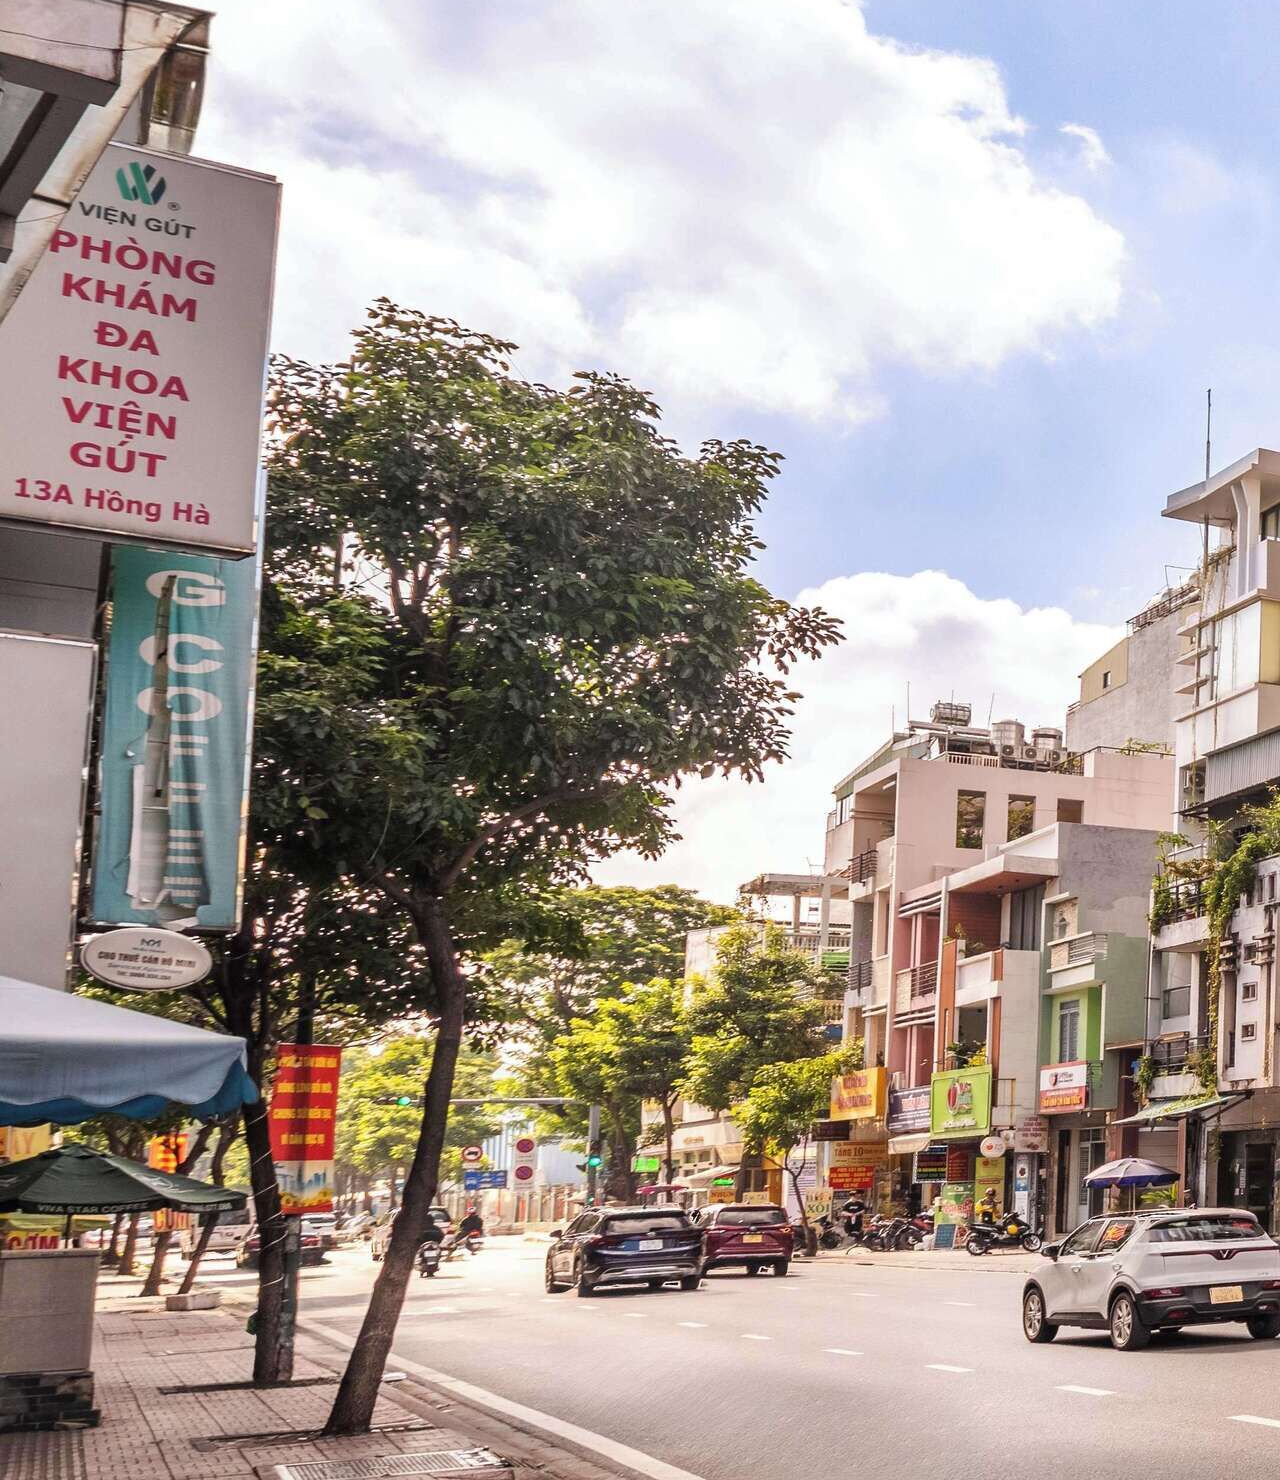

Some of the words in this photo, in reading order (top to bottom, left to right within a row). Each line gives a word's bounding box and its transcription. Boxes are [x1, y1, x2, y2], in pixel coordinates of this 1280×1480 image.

[78, 201, 135, 227] VIỆN
[145, 215, 196, 240] GÚT
[49, 228, 216, 286] PHÒNG
[62, 273, 197, 322] KHÁM
[94, 320, 161, 356] ĐA
[57, 355, 190, 402] KHOA
[61, 396, 177, 440] VIỆN
[70, 434, 167, 478] GÚT
[15, 478, 73, 505] 13A
[84, 486, 162, 522] Hồng
[173, 502, 210, 526] Hà
[38, 1205, 64, 1214] VIVA
[67, 1204, 98, 1214] STAR
[101, 1202, 148, 1213] COFFEE
